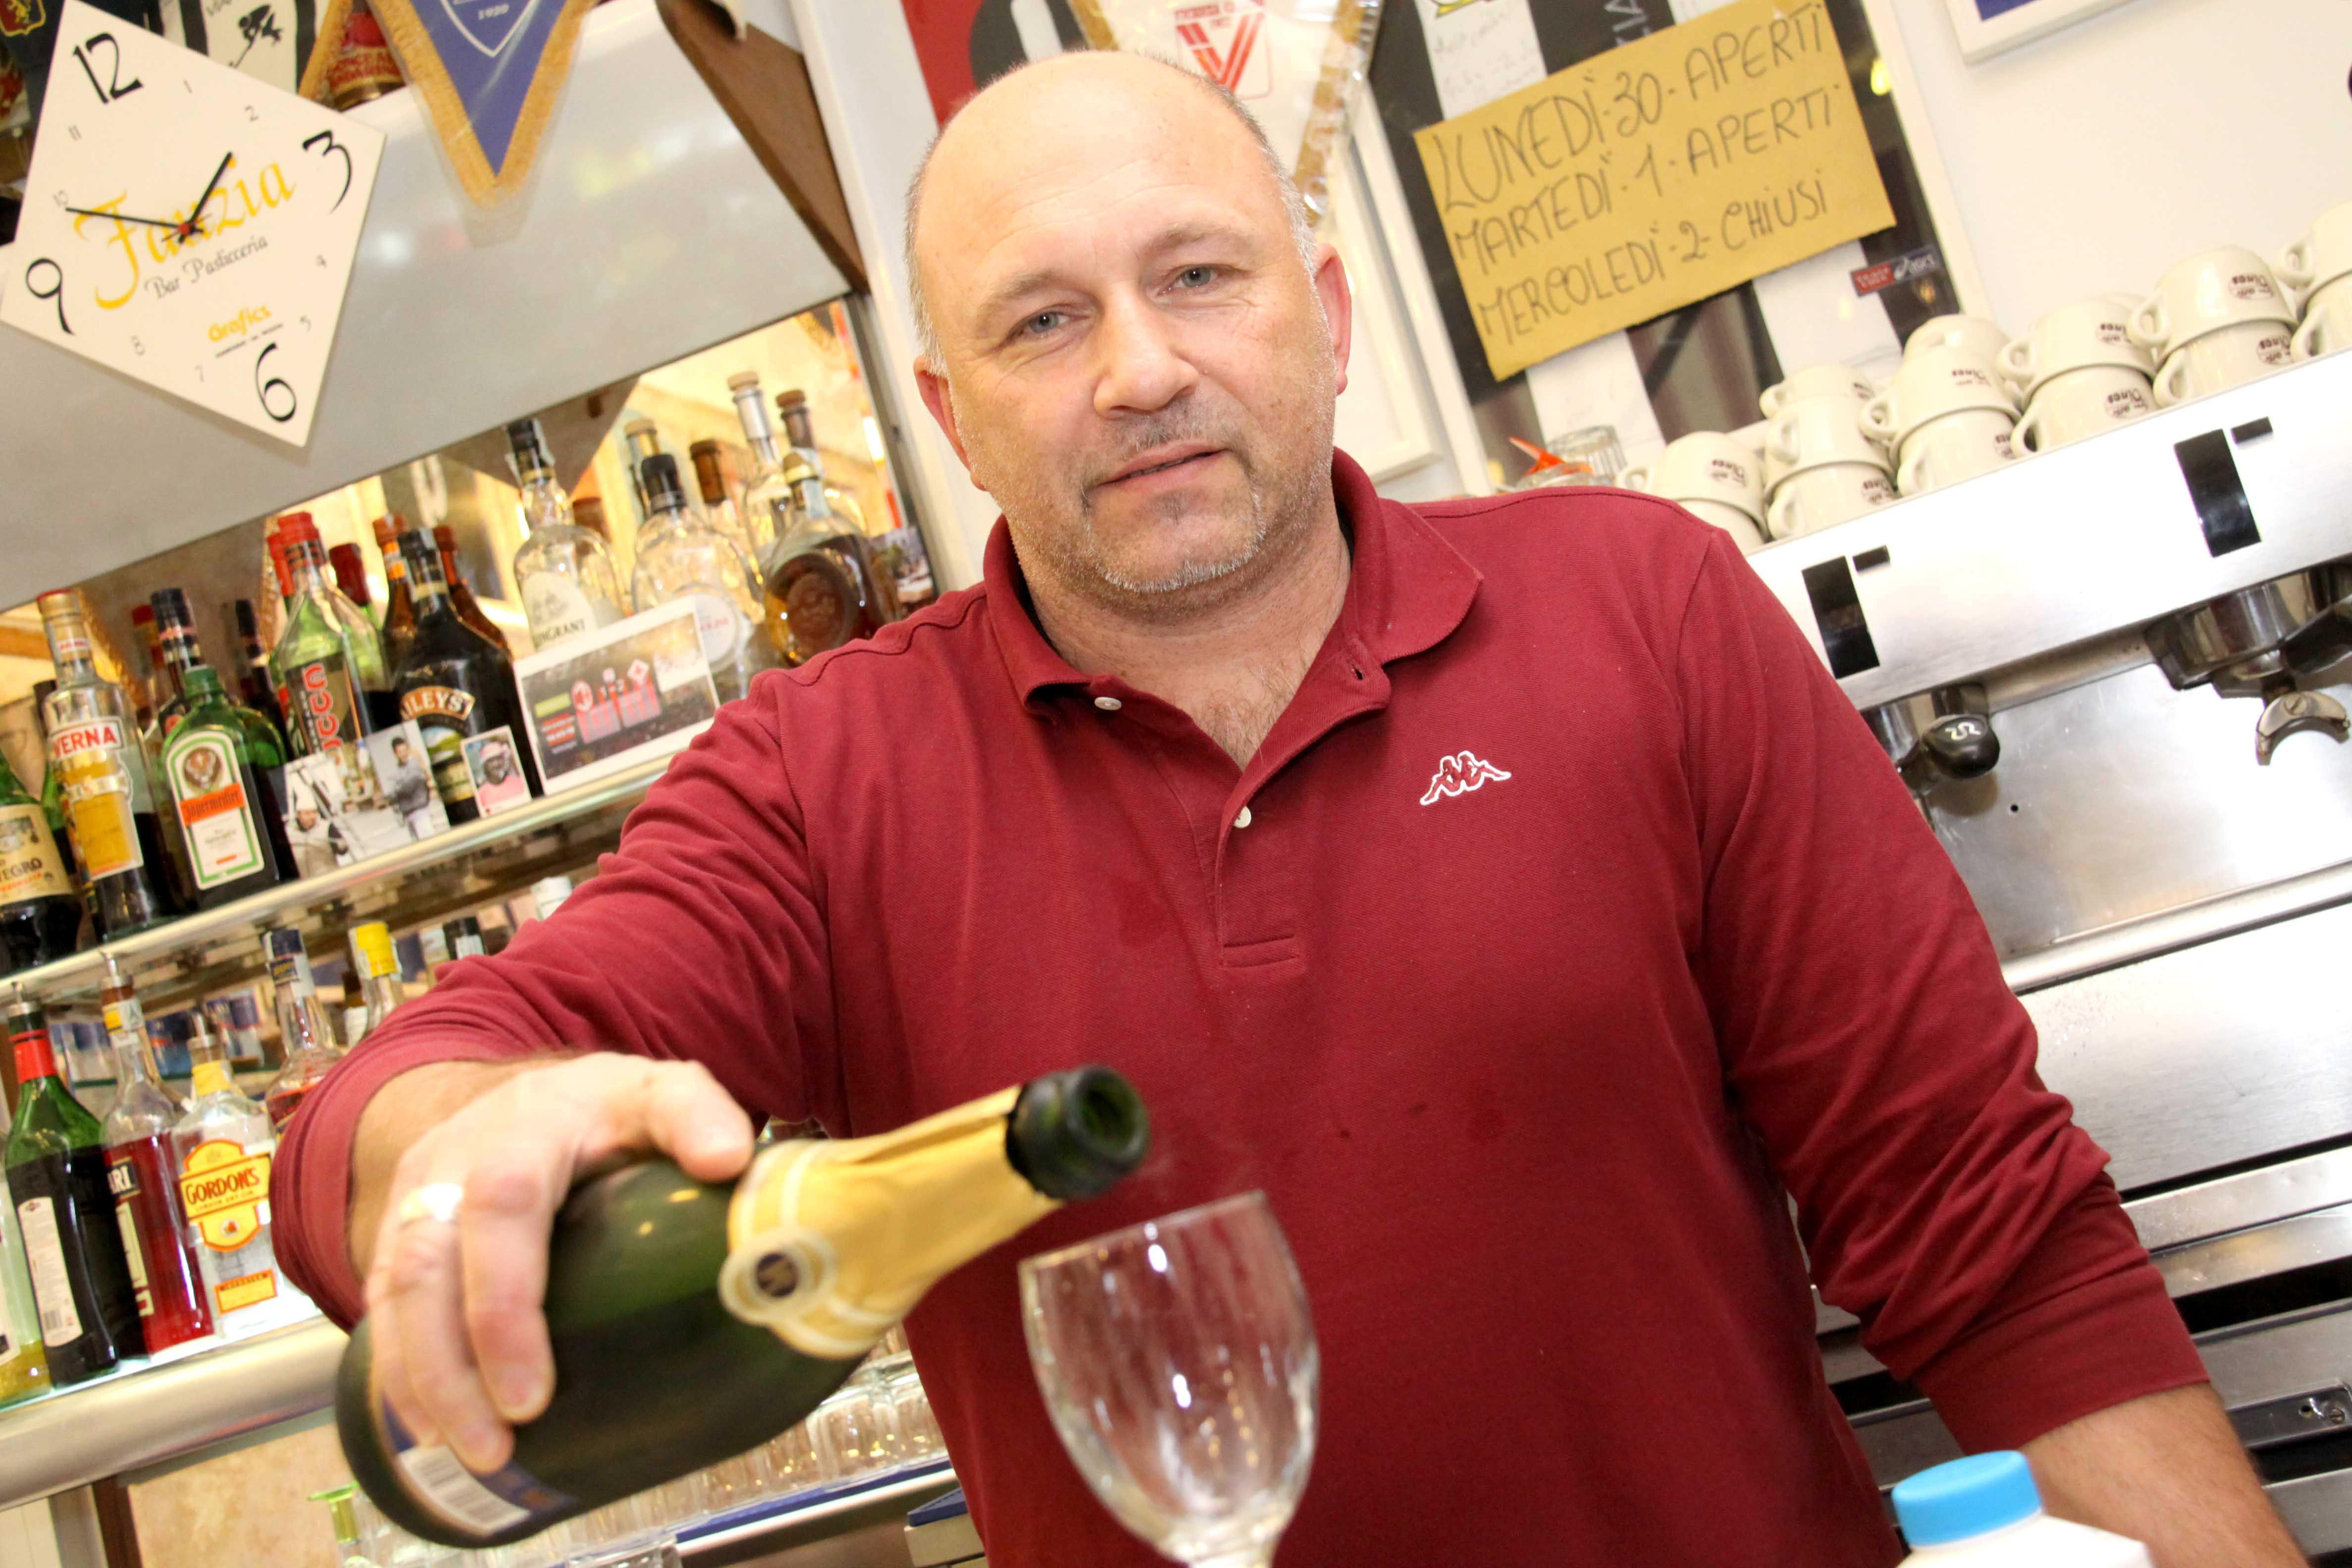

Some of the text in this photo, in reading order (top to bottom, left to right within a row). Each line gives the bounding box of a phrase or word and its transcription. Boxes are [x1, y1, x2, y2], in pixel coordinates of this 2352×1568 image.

[73, 32, 144, 104] 12
[244, 104, 259, 122] 2
[302, 130, 352, 214] 3
[25, 257, 75, 336] 9
[144, 235, 268, 300] Bar Pasticceria
[131, 336, 146, 356] 8
[255, 343, 297, 422] 6
